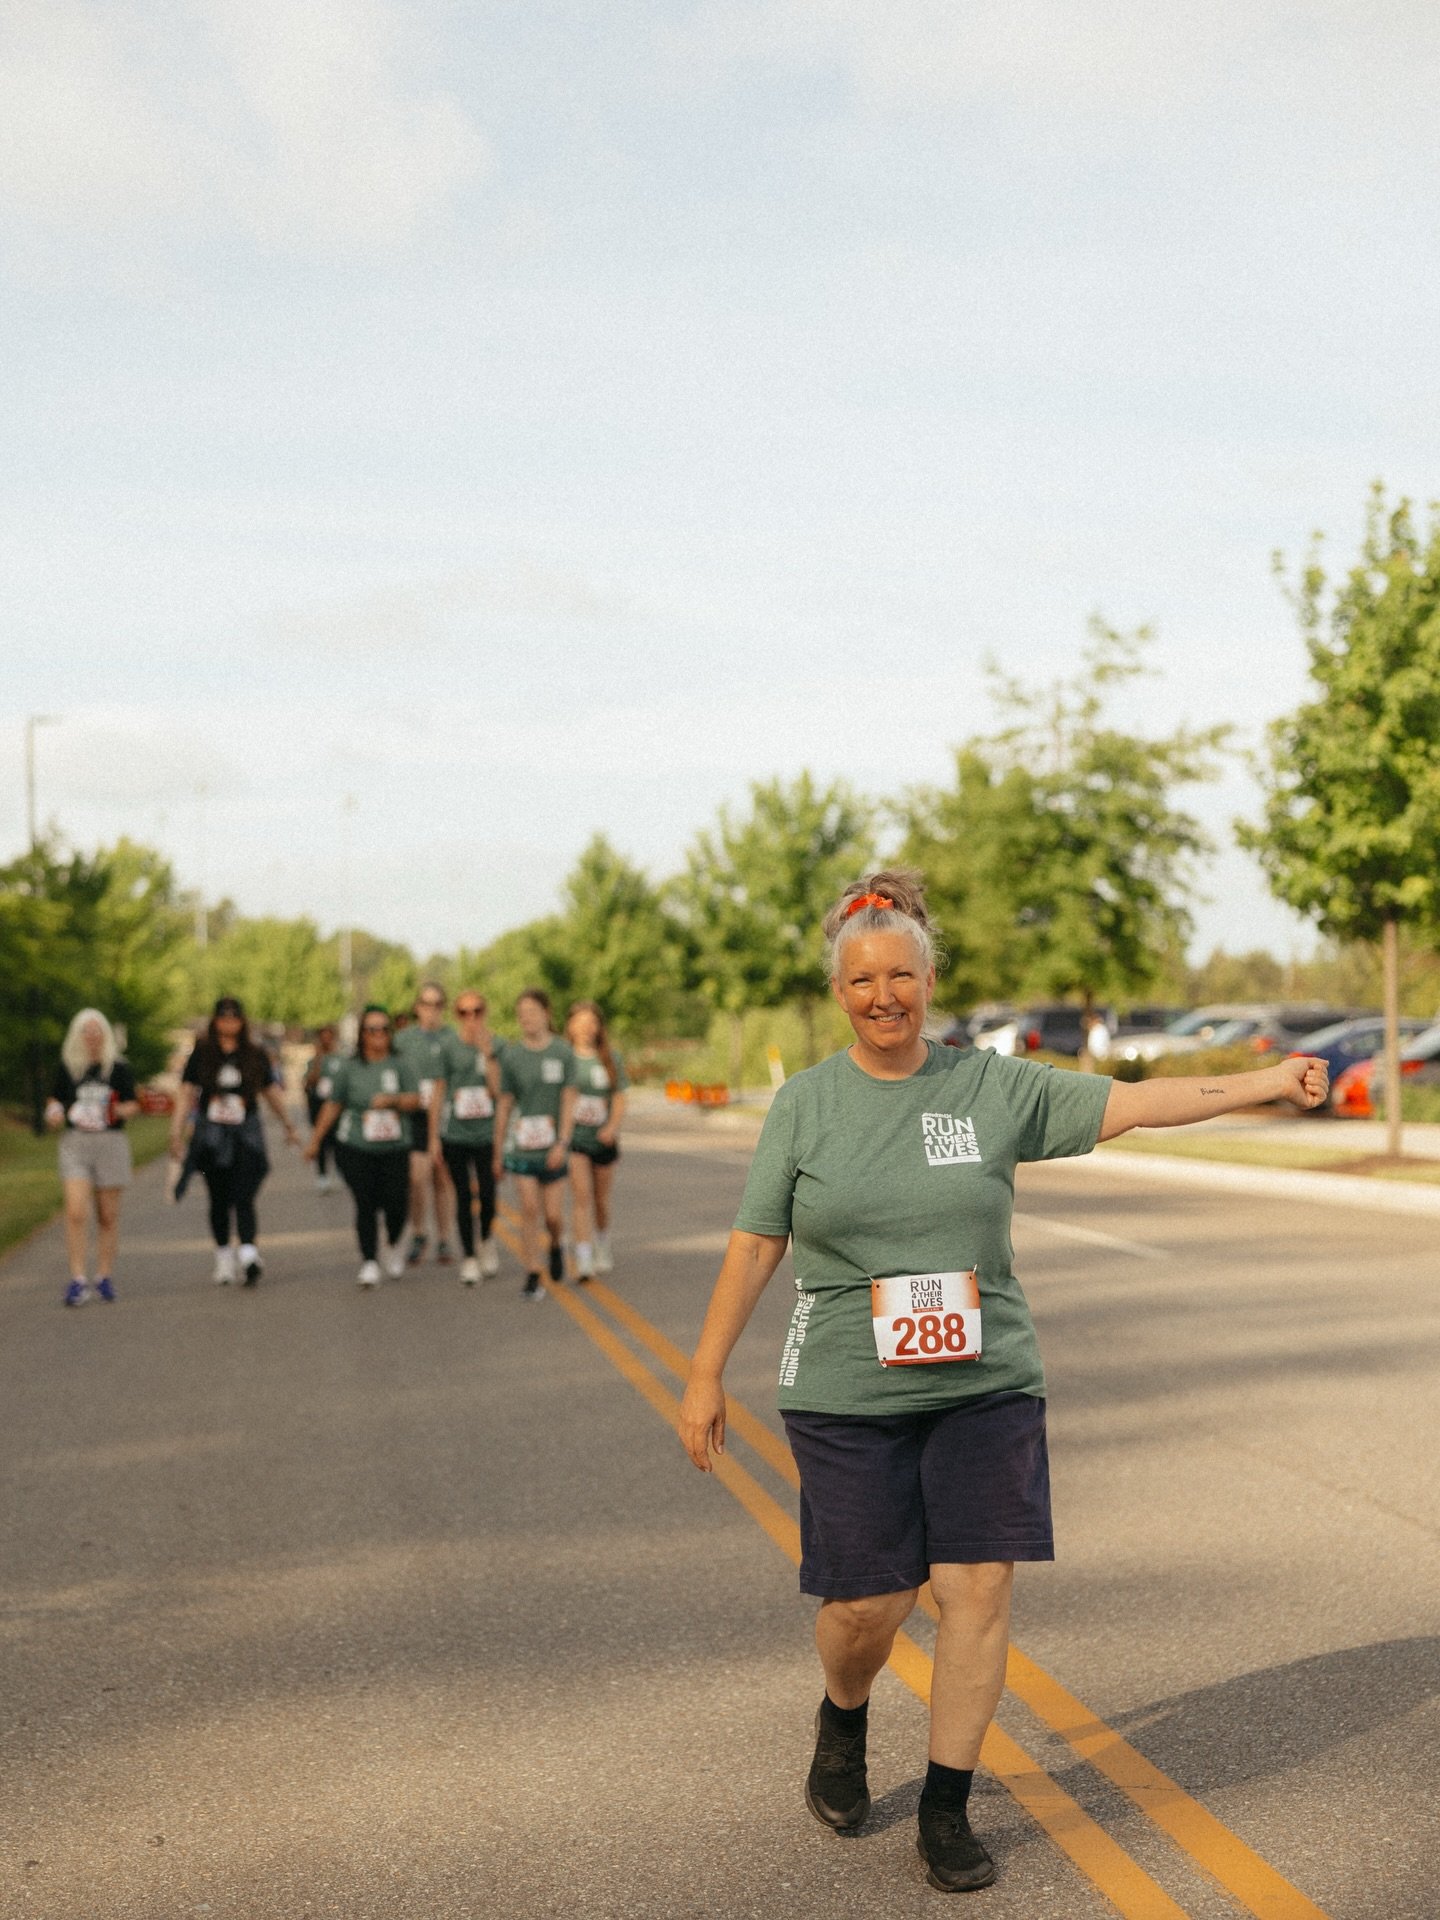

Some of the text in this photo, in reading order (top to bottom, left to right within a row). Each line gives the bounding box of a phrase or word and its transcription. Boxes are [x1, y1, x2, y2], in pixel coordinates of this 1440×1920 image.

[922, 1117, 974, 1135] RUN
[924, 1133, 976, 1145] 4 THEIR
[925, 1141, 979, 1158] LIVES
[910, 1279, 942, 1292] RUN
[912, 1297, 943, 1308] LIVES
[783, 1294, 815, 1386] DOING JUSTICE
[892, 1313, 966, 1356] 288
